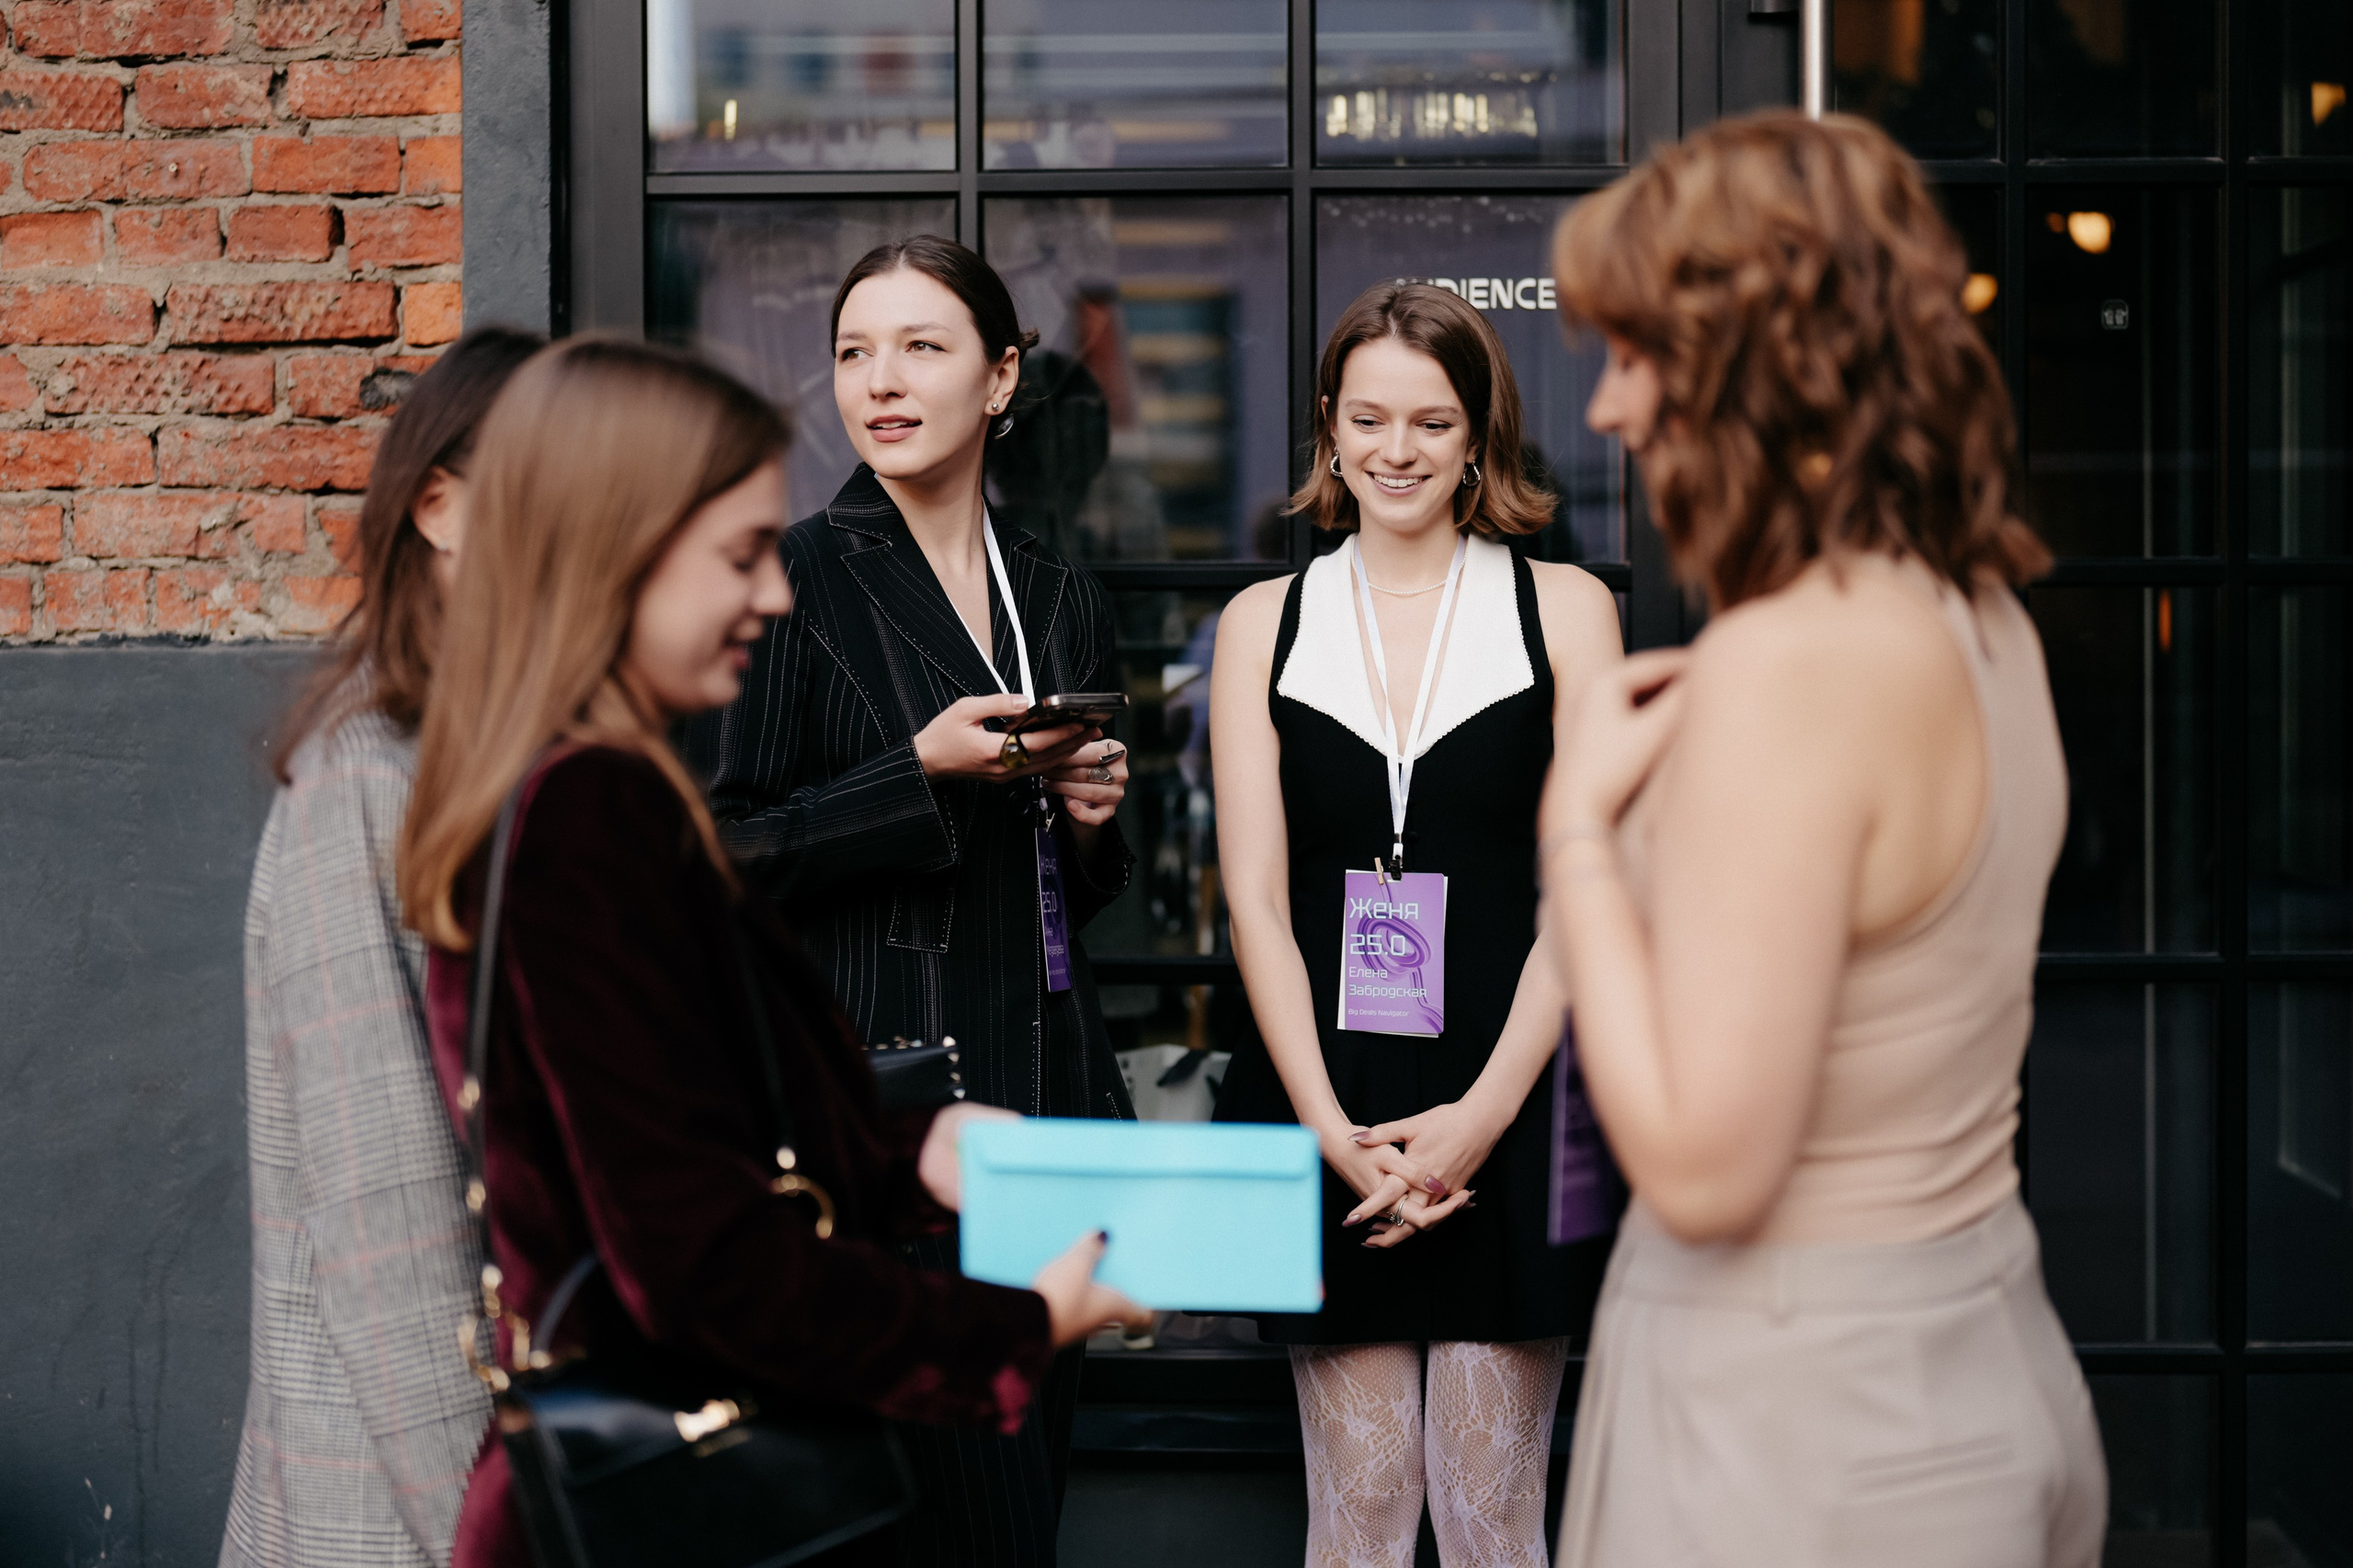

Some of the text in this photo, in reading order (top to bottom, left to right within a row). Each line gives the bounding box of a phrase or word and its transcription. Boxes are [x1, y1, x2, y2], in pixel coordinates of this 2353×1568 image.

[1349, 897, 1419, 920] Женя
[1349, 934, 1406, 956] 25.0
[1348, 966, 1388, 979] Елена
[1348, 984, 1427, 999] Забродская
[1348, 1008, 1358, 1017] Big
